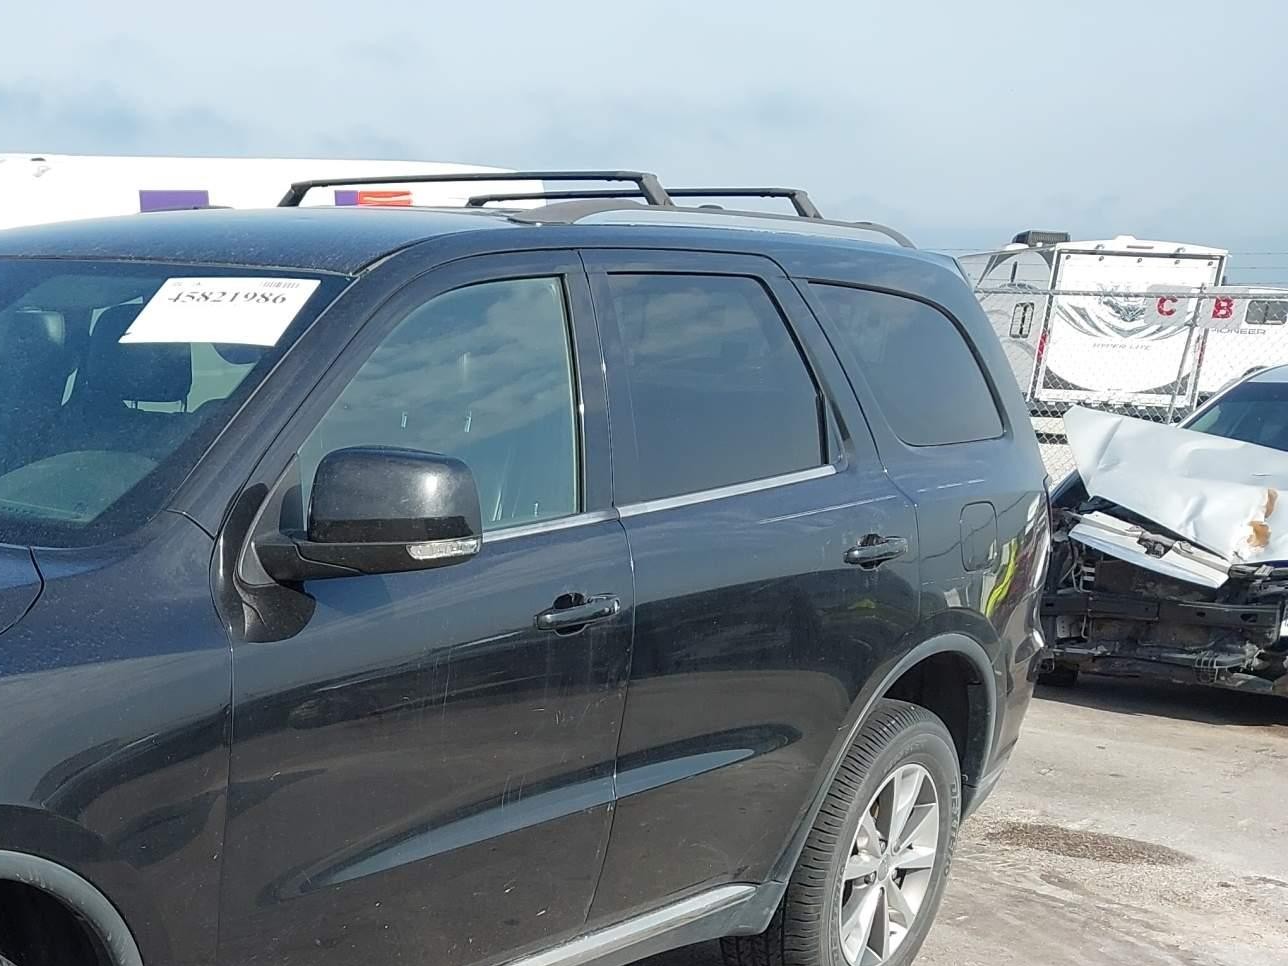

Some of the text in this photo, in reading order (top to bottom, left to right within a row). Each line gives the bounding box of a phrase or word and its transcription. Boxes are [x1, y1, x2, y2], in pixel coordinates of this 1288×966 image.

[167, 290, 288, 305] 45821986
[1156, 294, 1178, 317] C
[1211, 294, 1235, 320] B
